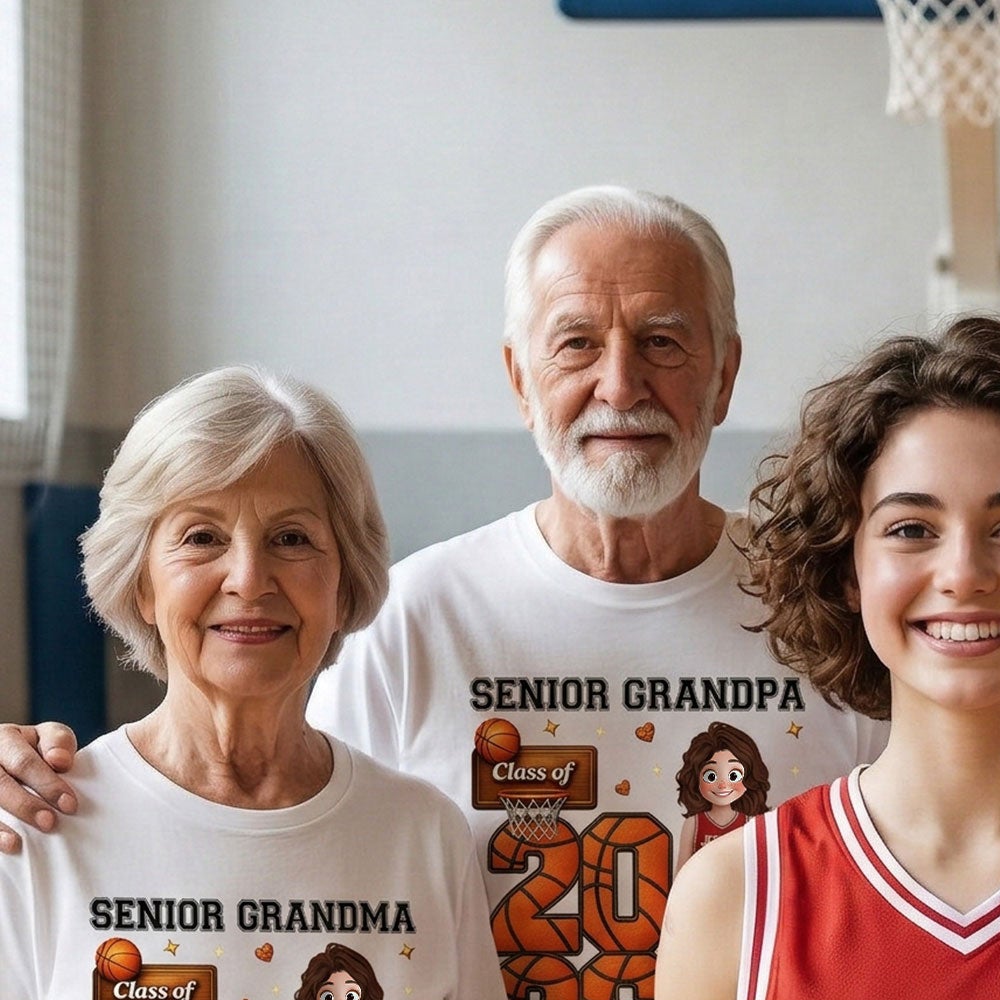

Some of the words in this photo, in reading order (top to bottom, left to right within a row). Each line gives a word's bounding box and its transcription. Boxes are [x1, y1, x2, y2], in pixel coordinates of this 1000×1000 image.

[469, 676, 610, 712] SENIOR
[621, 676, 806, 712] GRANDPA
[492, 762, 547, 782] Class
[551, 762, 577, 787] of
[487, 811, 674, 956] 20
[89, 896, 225, 932] SENIOR
[236, 898, 417, 934] GRANDMA
